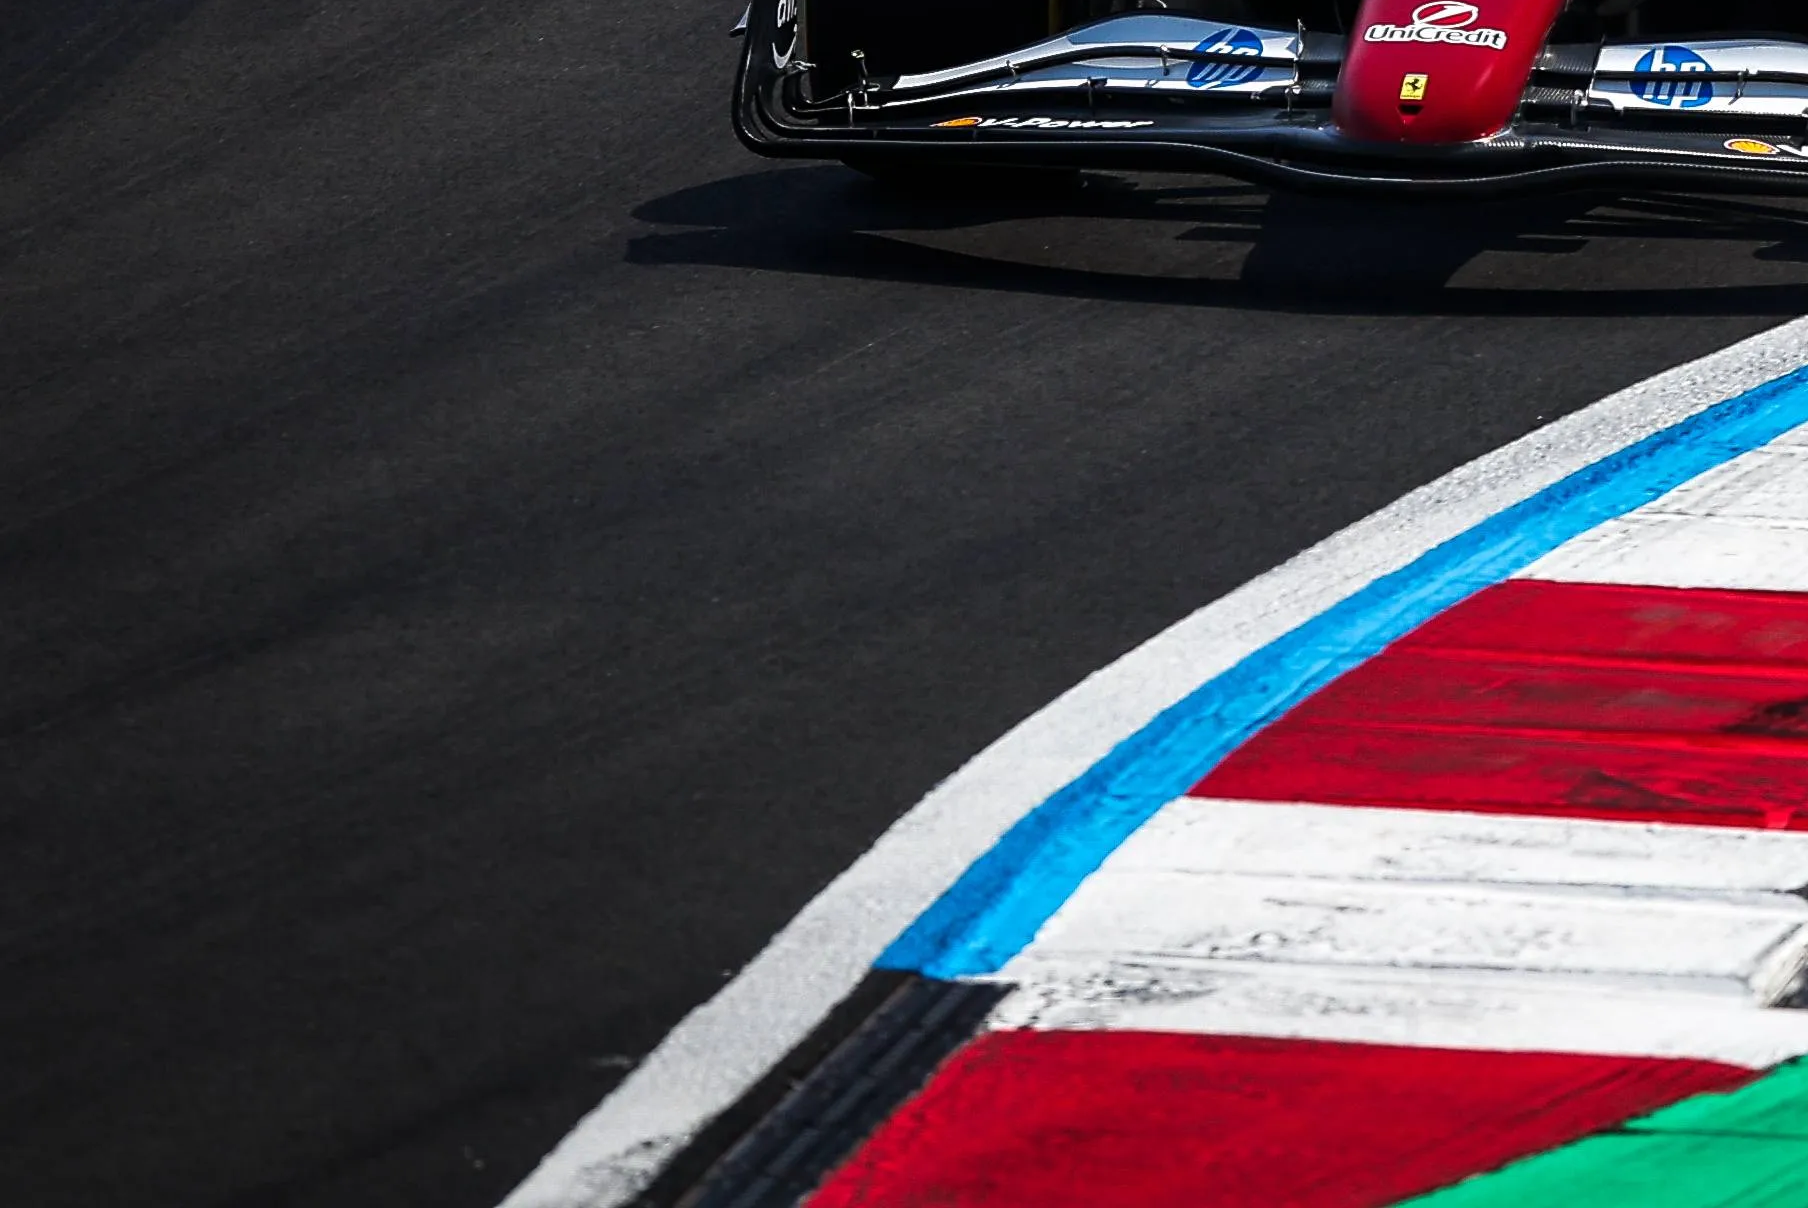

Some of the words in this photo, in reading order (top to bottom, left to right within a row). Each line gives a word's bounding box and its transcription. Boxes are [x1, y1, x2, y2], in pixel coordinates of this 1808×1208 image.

[1192, 28, 1260, 90] hp
[1365, 23, 1507, 50] UniCredit
[1641, 45, 1707, 108] hp
